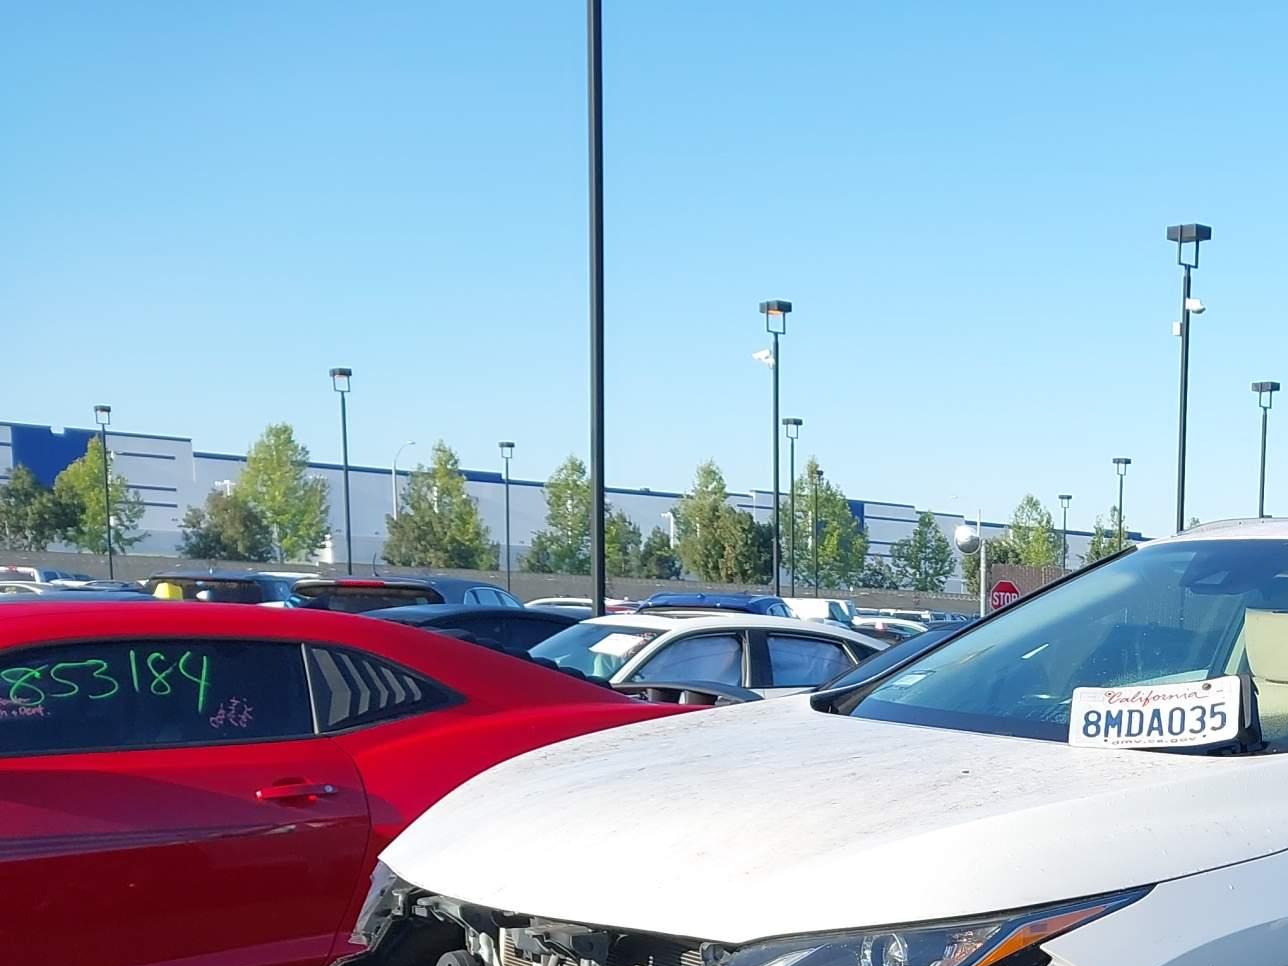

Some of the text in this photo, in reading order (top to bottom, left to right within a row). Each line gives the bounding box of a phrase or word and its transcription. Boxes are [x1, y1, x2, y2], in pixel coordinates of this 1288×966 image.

[992, 592, 1018, 606] STOP
[1105, 689, 1208, 707] California
[1082, 702, 1227, 738] 8MDA035
